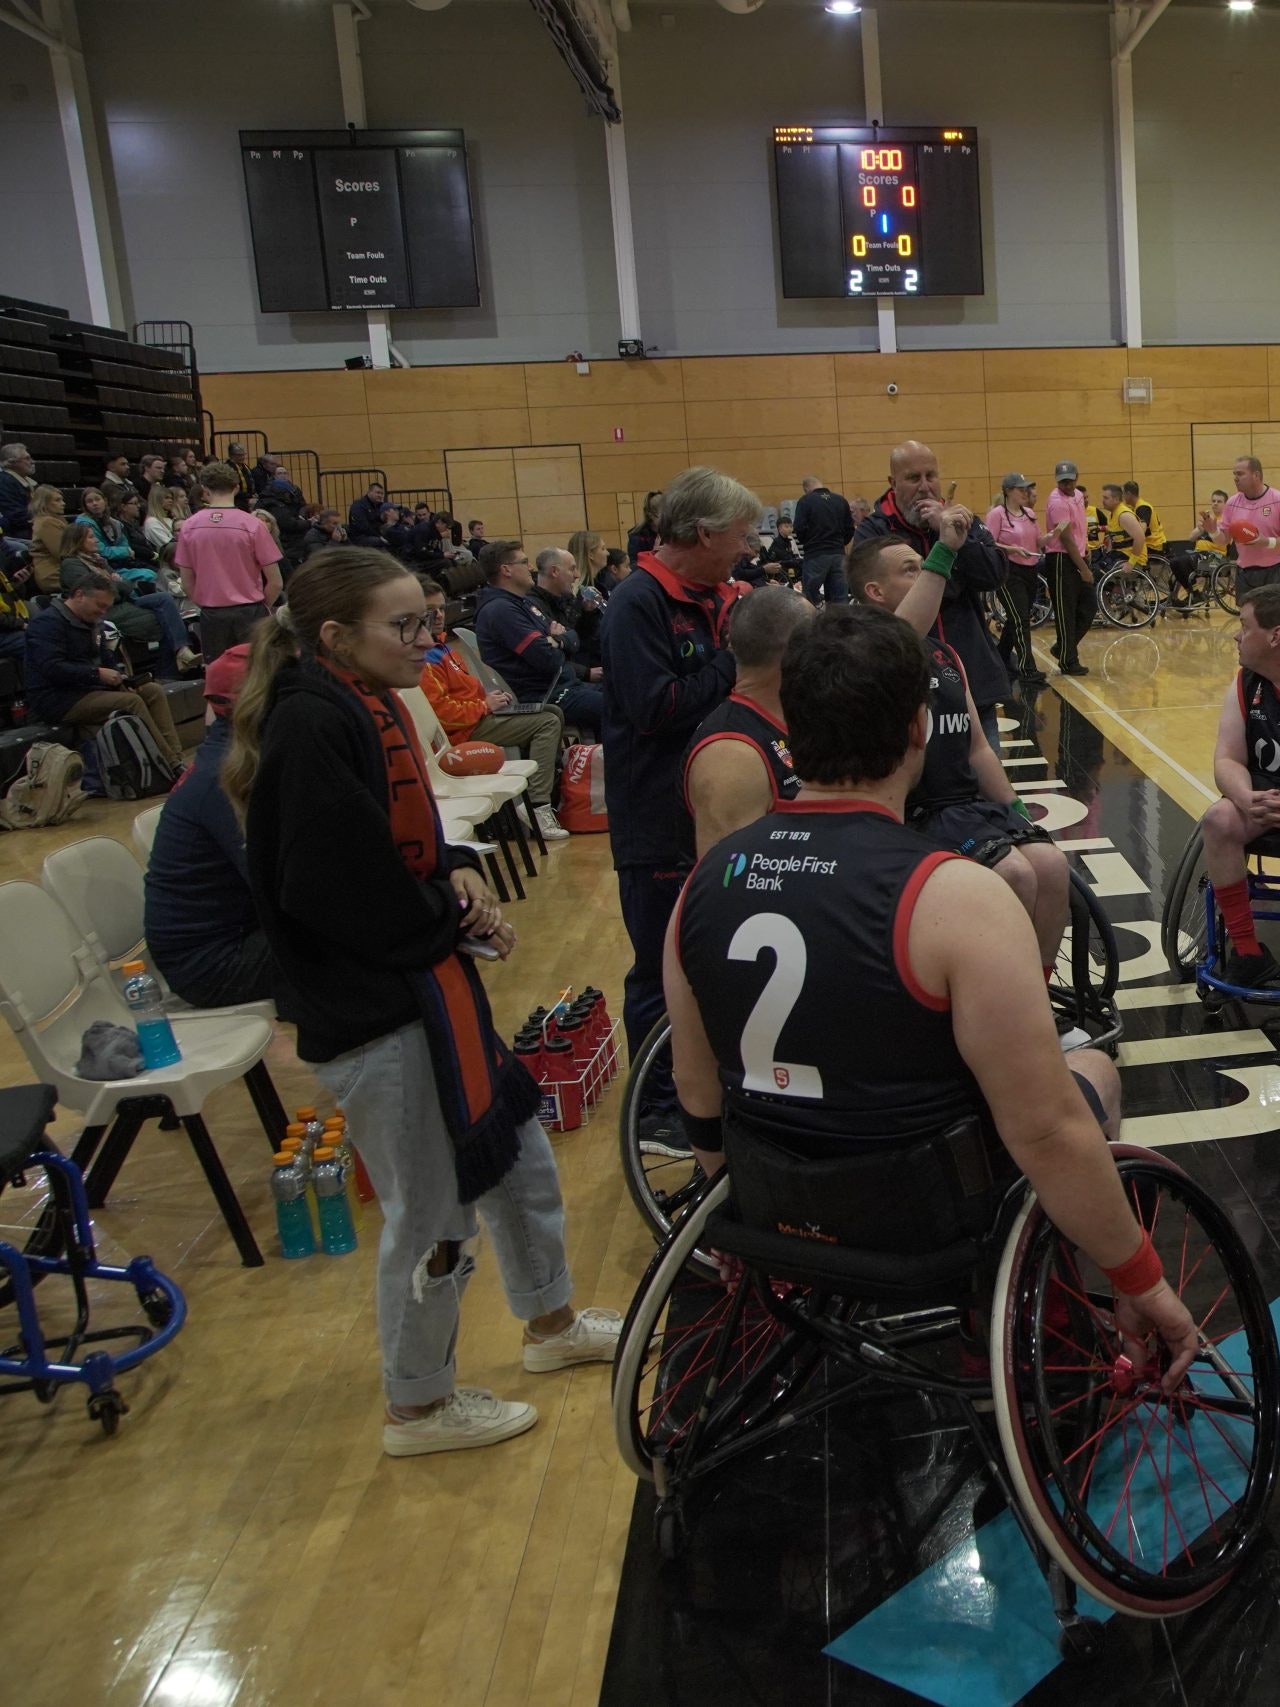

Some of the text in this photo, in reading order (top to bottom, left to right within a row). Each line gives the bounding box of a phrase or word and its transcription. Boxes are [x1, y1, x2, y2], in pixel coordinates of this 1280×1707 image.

[861, 149, 902, 170] 10:00
[335, 178, 380, 193] Scores
[858, 173, 899, 185] Scores
[863, 186, 876, 207] 0
[902, 186, 915, 207] 0
[350, 217, 357, 227] P
[870, 210, 876, 218] P
[853, 235, 866, 256] 0
[898, 235, 911, 256] 0
[347, 251, 385, 260] Team Fouls
[866, 264, 901, 272] Time Outs
[349, 275, 388, 284] Time Outs
[849, 270, 863, 292] 2
[905, 269, 918, 291] 2
[939, 713, 971, 735] IWS
[465, 747, 495, 756] novita
[769, 831, 811, 842] EST 1878
[746, 873, 783, 892] Bank
[727, 912, 823, 1099] 2
